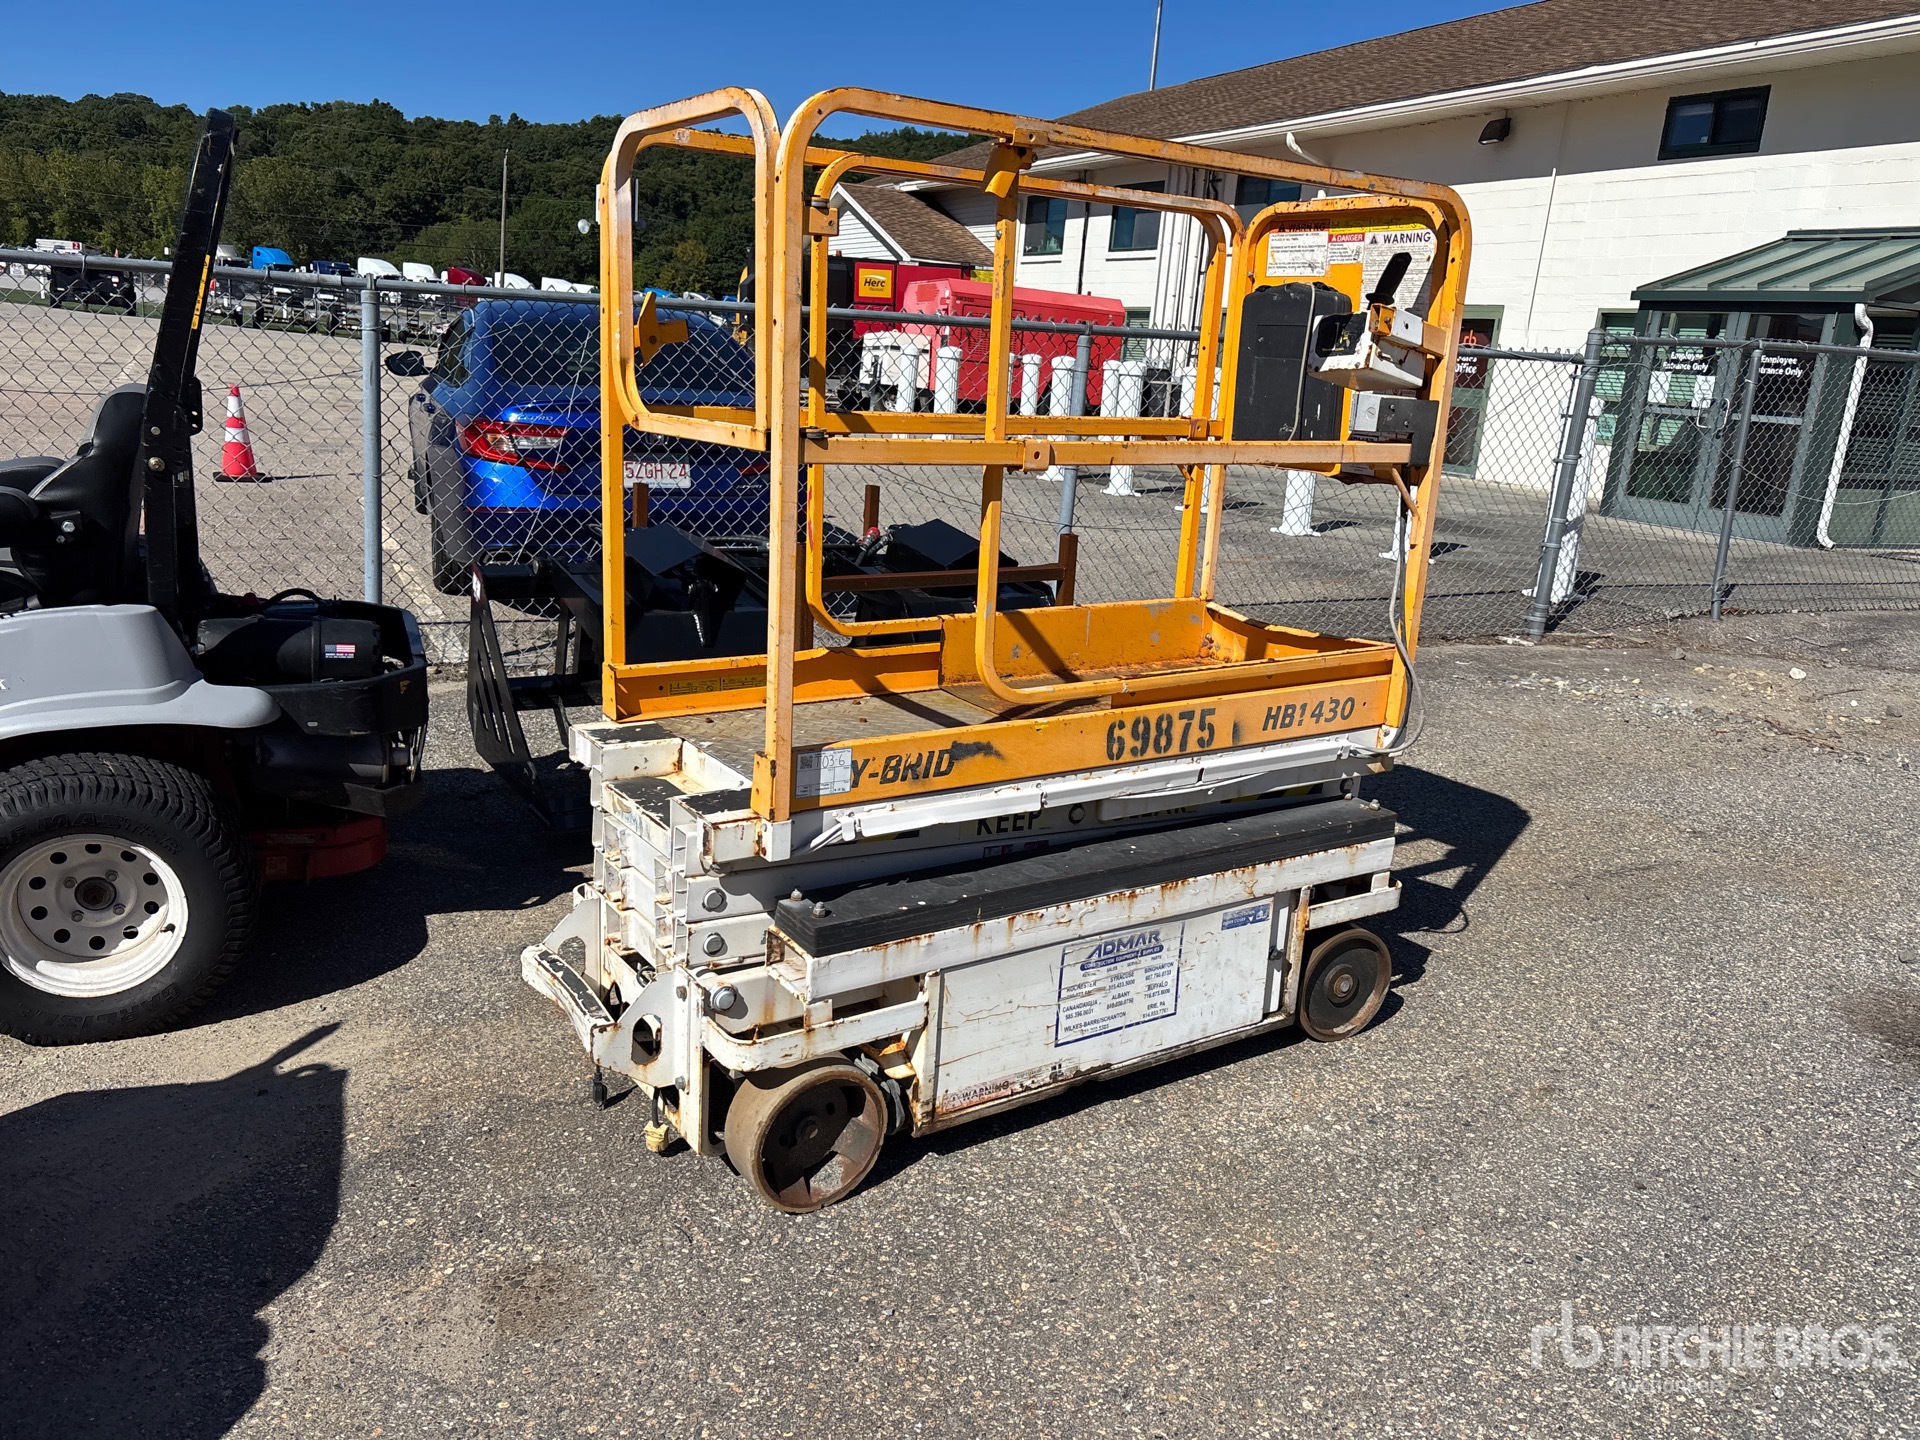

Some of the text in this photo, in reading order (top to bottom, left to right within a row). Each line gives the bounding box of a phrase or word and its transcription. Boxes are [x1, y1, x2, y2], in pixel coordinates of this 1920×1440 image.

[1337, 234, 1363, 242] DANGER
[1383, 232, 1431, 244] WARNING
[864, 278, 886, 287] Herc
[1670, 351, 1704, 361] Employee
[1760, 354, 1798, 365] Employee
[1692, 362, 1709, 372] Only
[1758, 366, 1803, 377] trance Only
[668, 462, 687, 479] 24
[1106, 707, 1216, 761] 69875
[851, 749, 955, 788] Y-BRID
[976, 810, 1042, 836] KEEP
[1086, 930, 1162, 959] ADMAR
